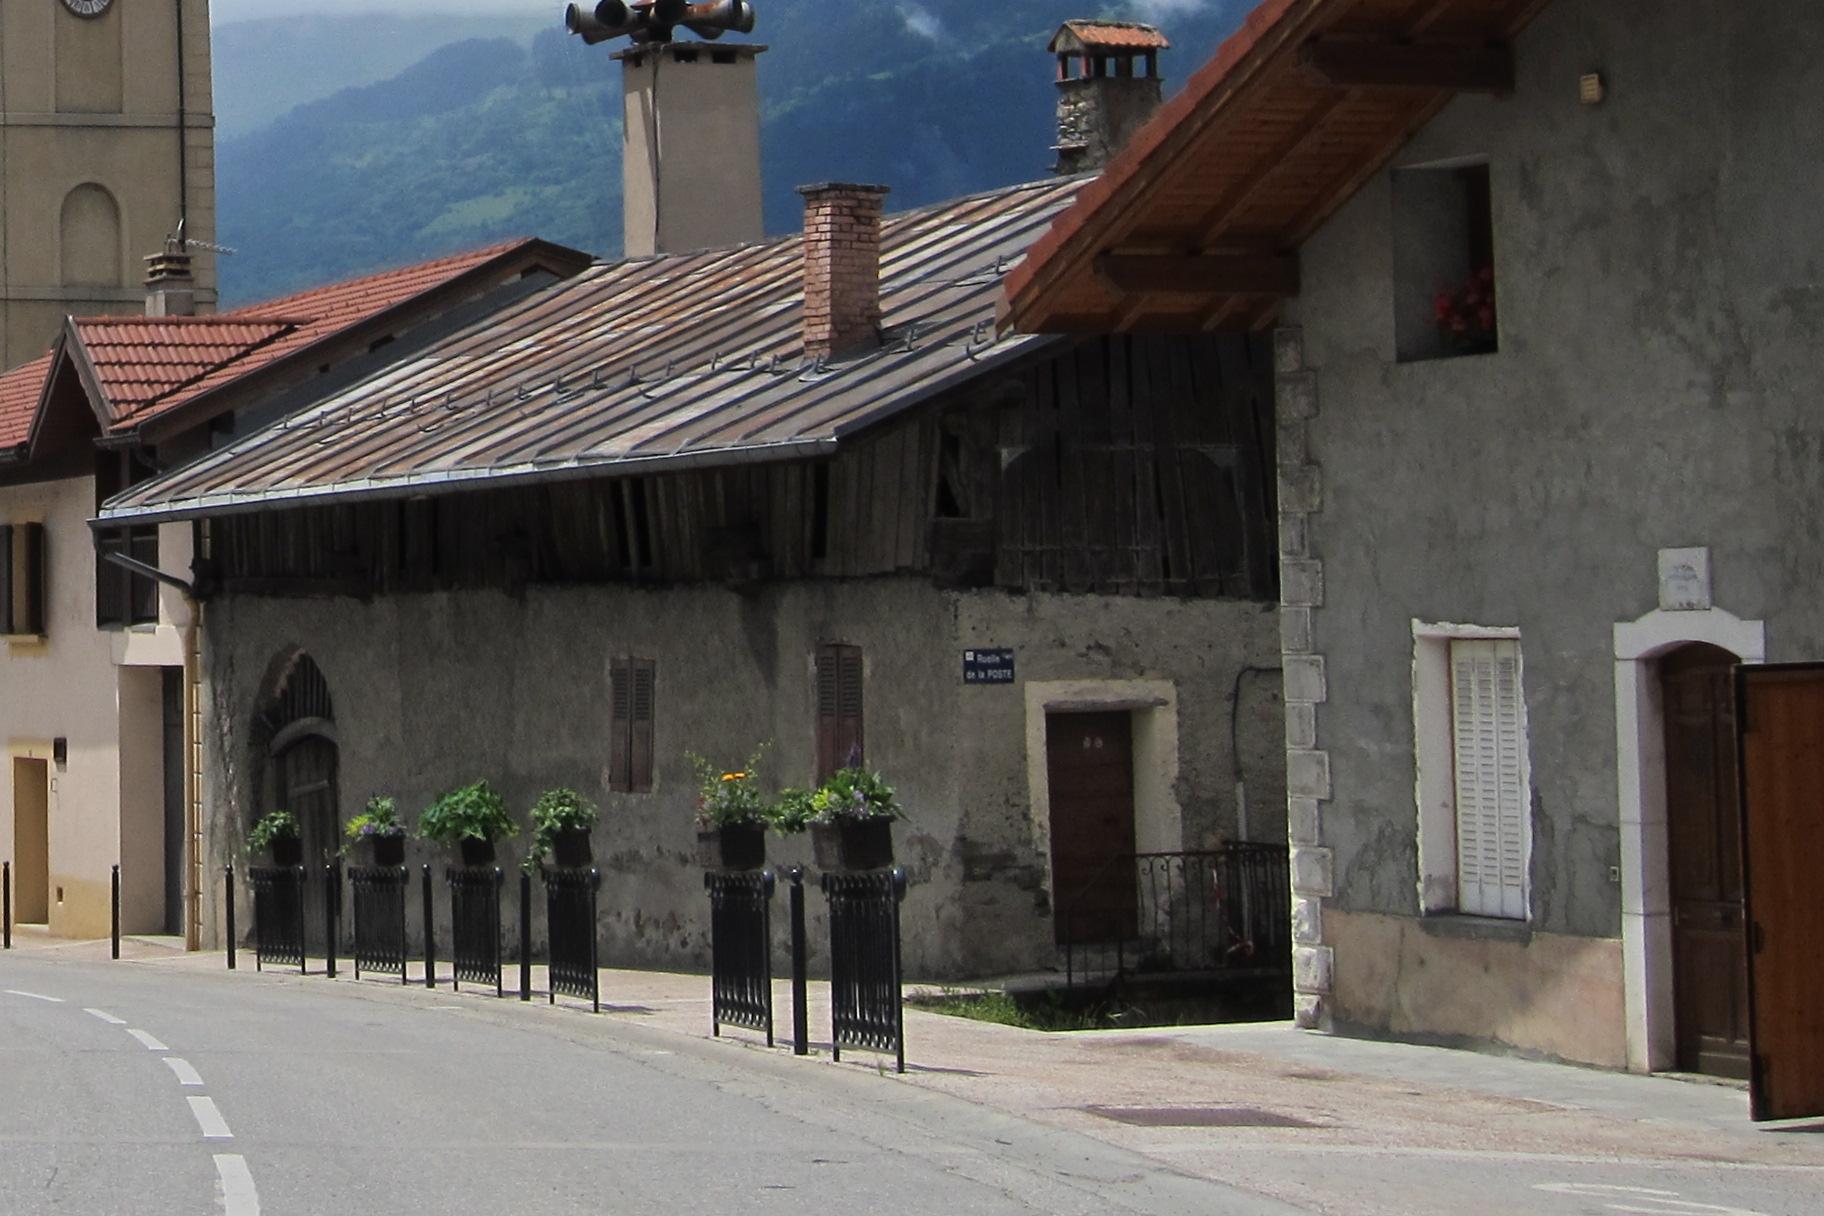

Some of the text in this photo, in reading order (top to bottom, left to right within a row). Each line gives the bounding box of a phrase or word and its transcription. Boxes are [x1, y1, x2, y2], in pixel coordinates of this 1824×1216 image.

[977, 654, 1000, 664] Ruelle
[966, 670, 1012, 679] de la POSTE
